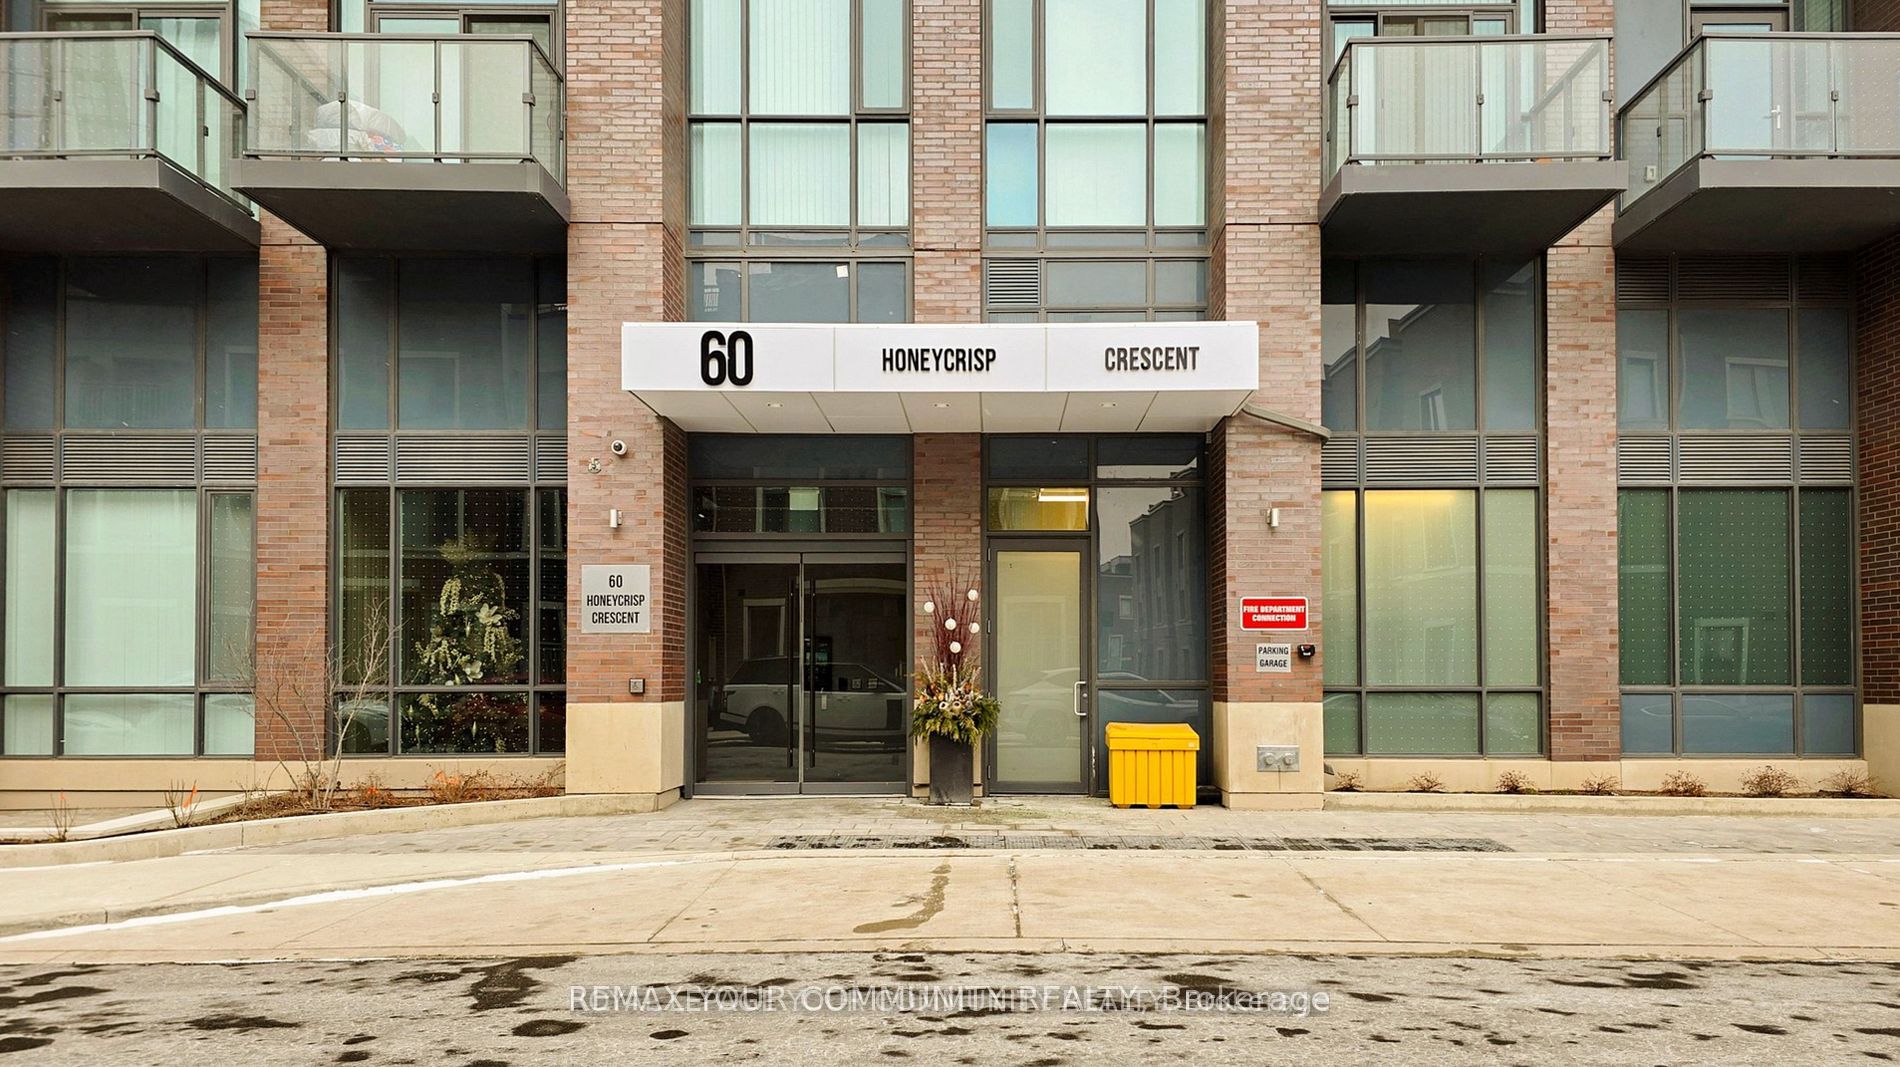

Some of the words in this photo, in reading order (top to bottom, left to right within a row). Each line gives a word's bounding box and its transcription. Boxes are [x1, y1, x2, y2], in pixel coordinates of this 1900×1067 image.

[700, 330, 754, 387] 60
[882, 347, 997, 373] HONEYCRISP
[1104, 346, 1200, 372] CRESCENT
[608, 574, 623, 589] 60
[586, 594, 646, 607] HONEYCRISP
[1243, 605, 1259, 613] FIRE
[1260, 605, 1305, 613] DEPARTMENT
[591, 611, 640, 624] CRESCENT
[1251, 613, 1297, 622] CONNECTION
[1258, 646, 1289, 655] PARKING
[1259, 658, 1288, 668] GARAGE
